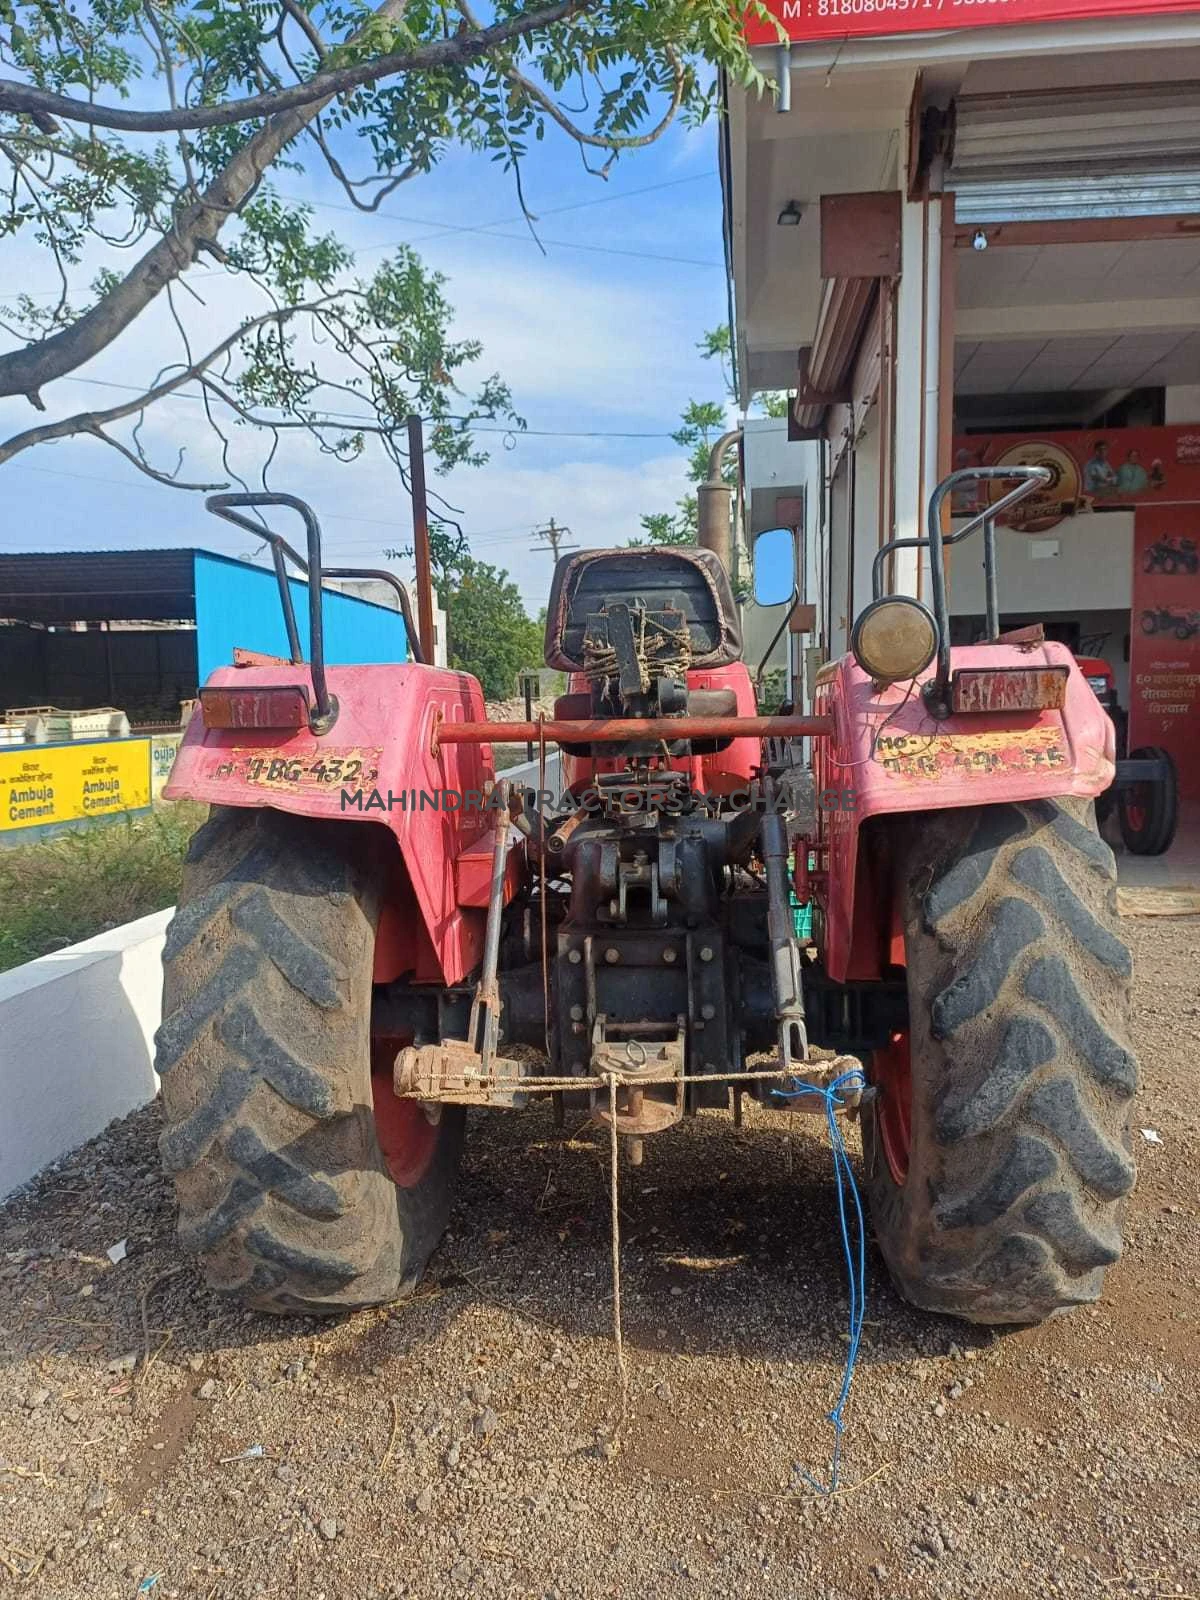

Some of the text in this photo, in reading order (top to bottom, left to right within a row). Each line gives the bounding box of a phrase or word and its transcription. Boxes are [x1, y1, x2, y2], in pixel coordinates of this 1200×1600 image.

[783, 1, 800, 19] M
[9, 785, 54, 804] Ambuja
[83, 778, 120, 794] Ambuja
[82, 792, 120, 809] Cement
[9, 802, 55, 821] Cement
